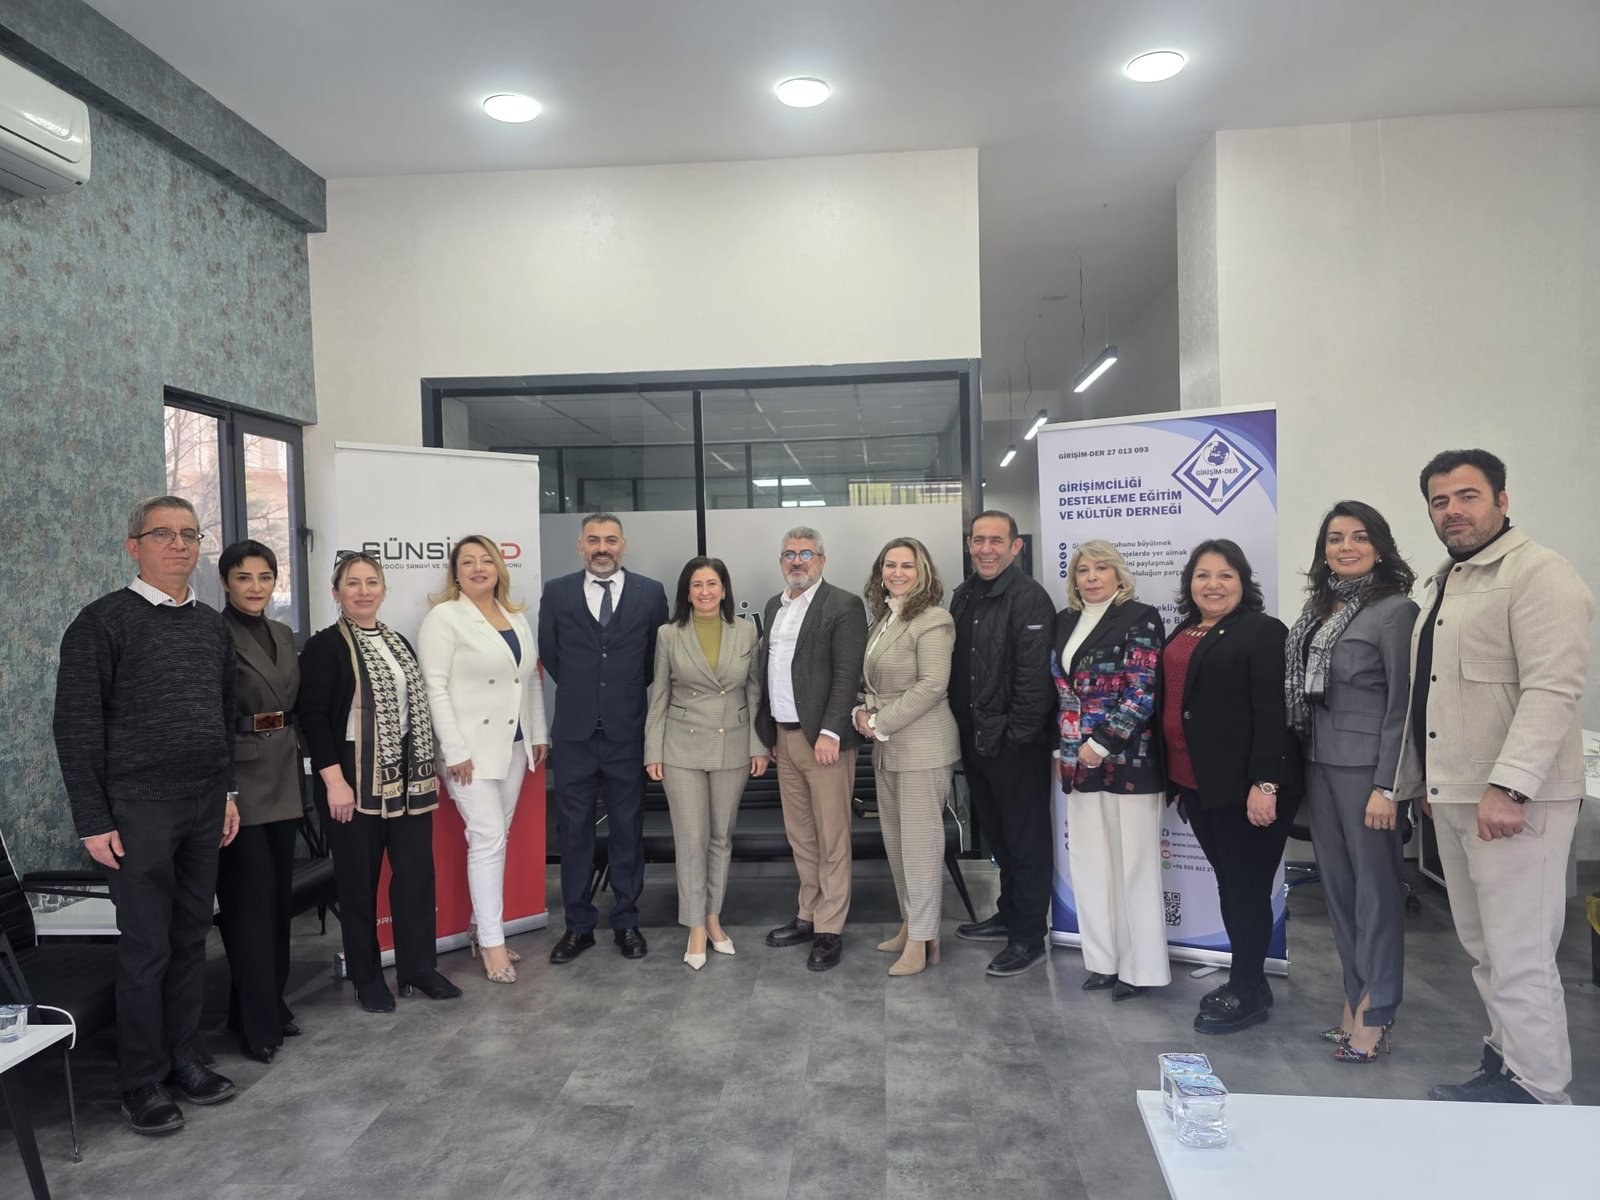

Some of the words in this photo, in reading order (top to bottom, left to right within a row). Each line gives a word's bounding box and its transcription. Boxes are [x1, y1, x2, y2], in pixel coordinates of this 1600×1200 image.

[1058, 450, 1105, 460] GİRİŞİM-DER
[1118, 447, 1133, 455] 013
[1134, 446, 1149, 454] 093
[1196, 467, 1239, 476] GİRİŞİM-DER
[1058, 475, 1142, 494] GİRİŞİMCİLİĞİ
[1059, 493, 1136, 506] DESTEKLEME
[1139, 488, 1182, 502] EĞİTİM
[1059, 510, 1074, 520] VE
[1077, 506, 1123, 519] KÜLTÜR
[1126, 502, 1182, 517] DERNEĞİ
[362, 537, 521, 560] GÜNSİD
[1137, 540, 1172, 549] büyütmek
[1120, 550, 1150, 558] rojelerde
[1136, 560, 1174, 568] paylaşmak
